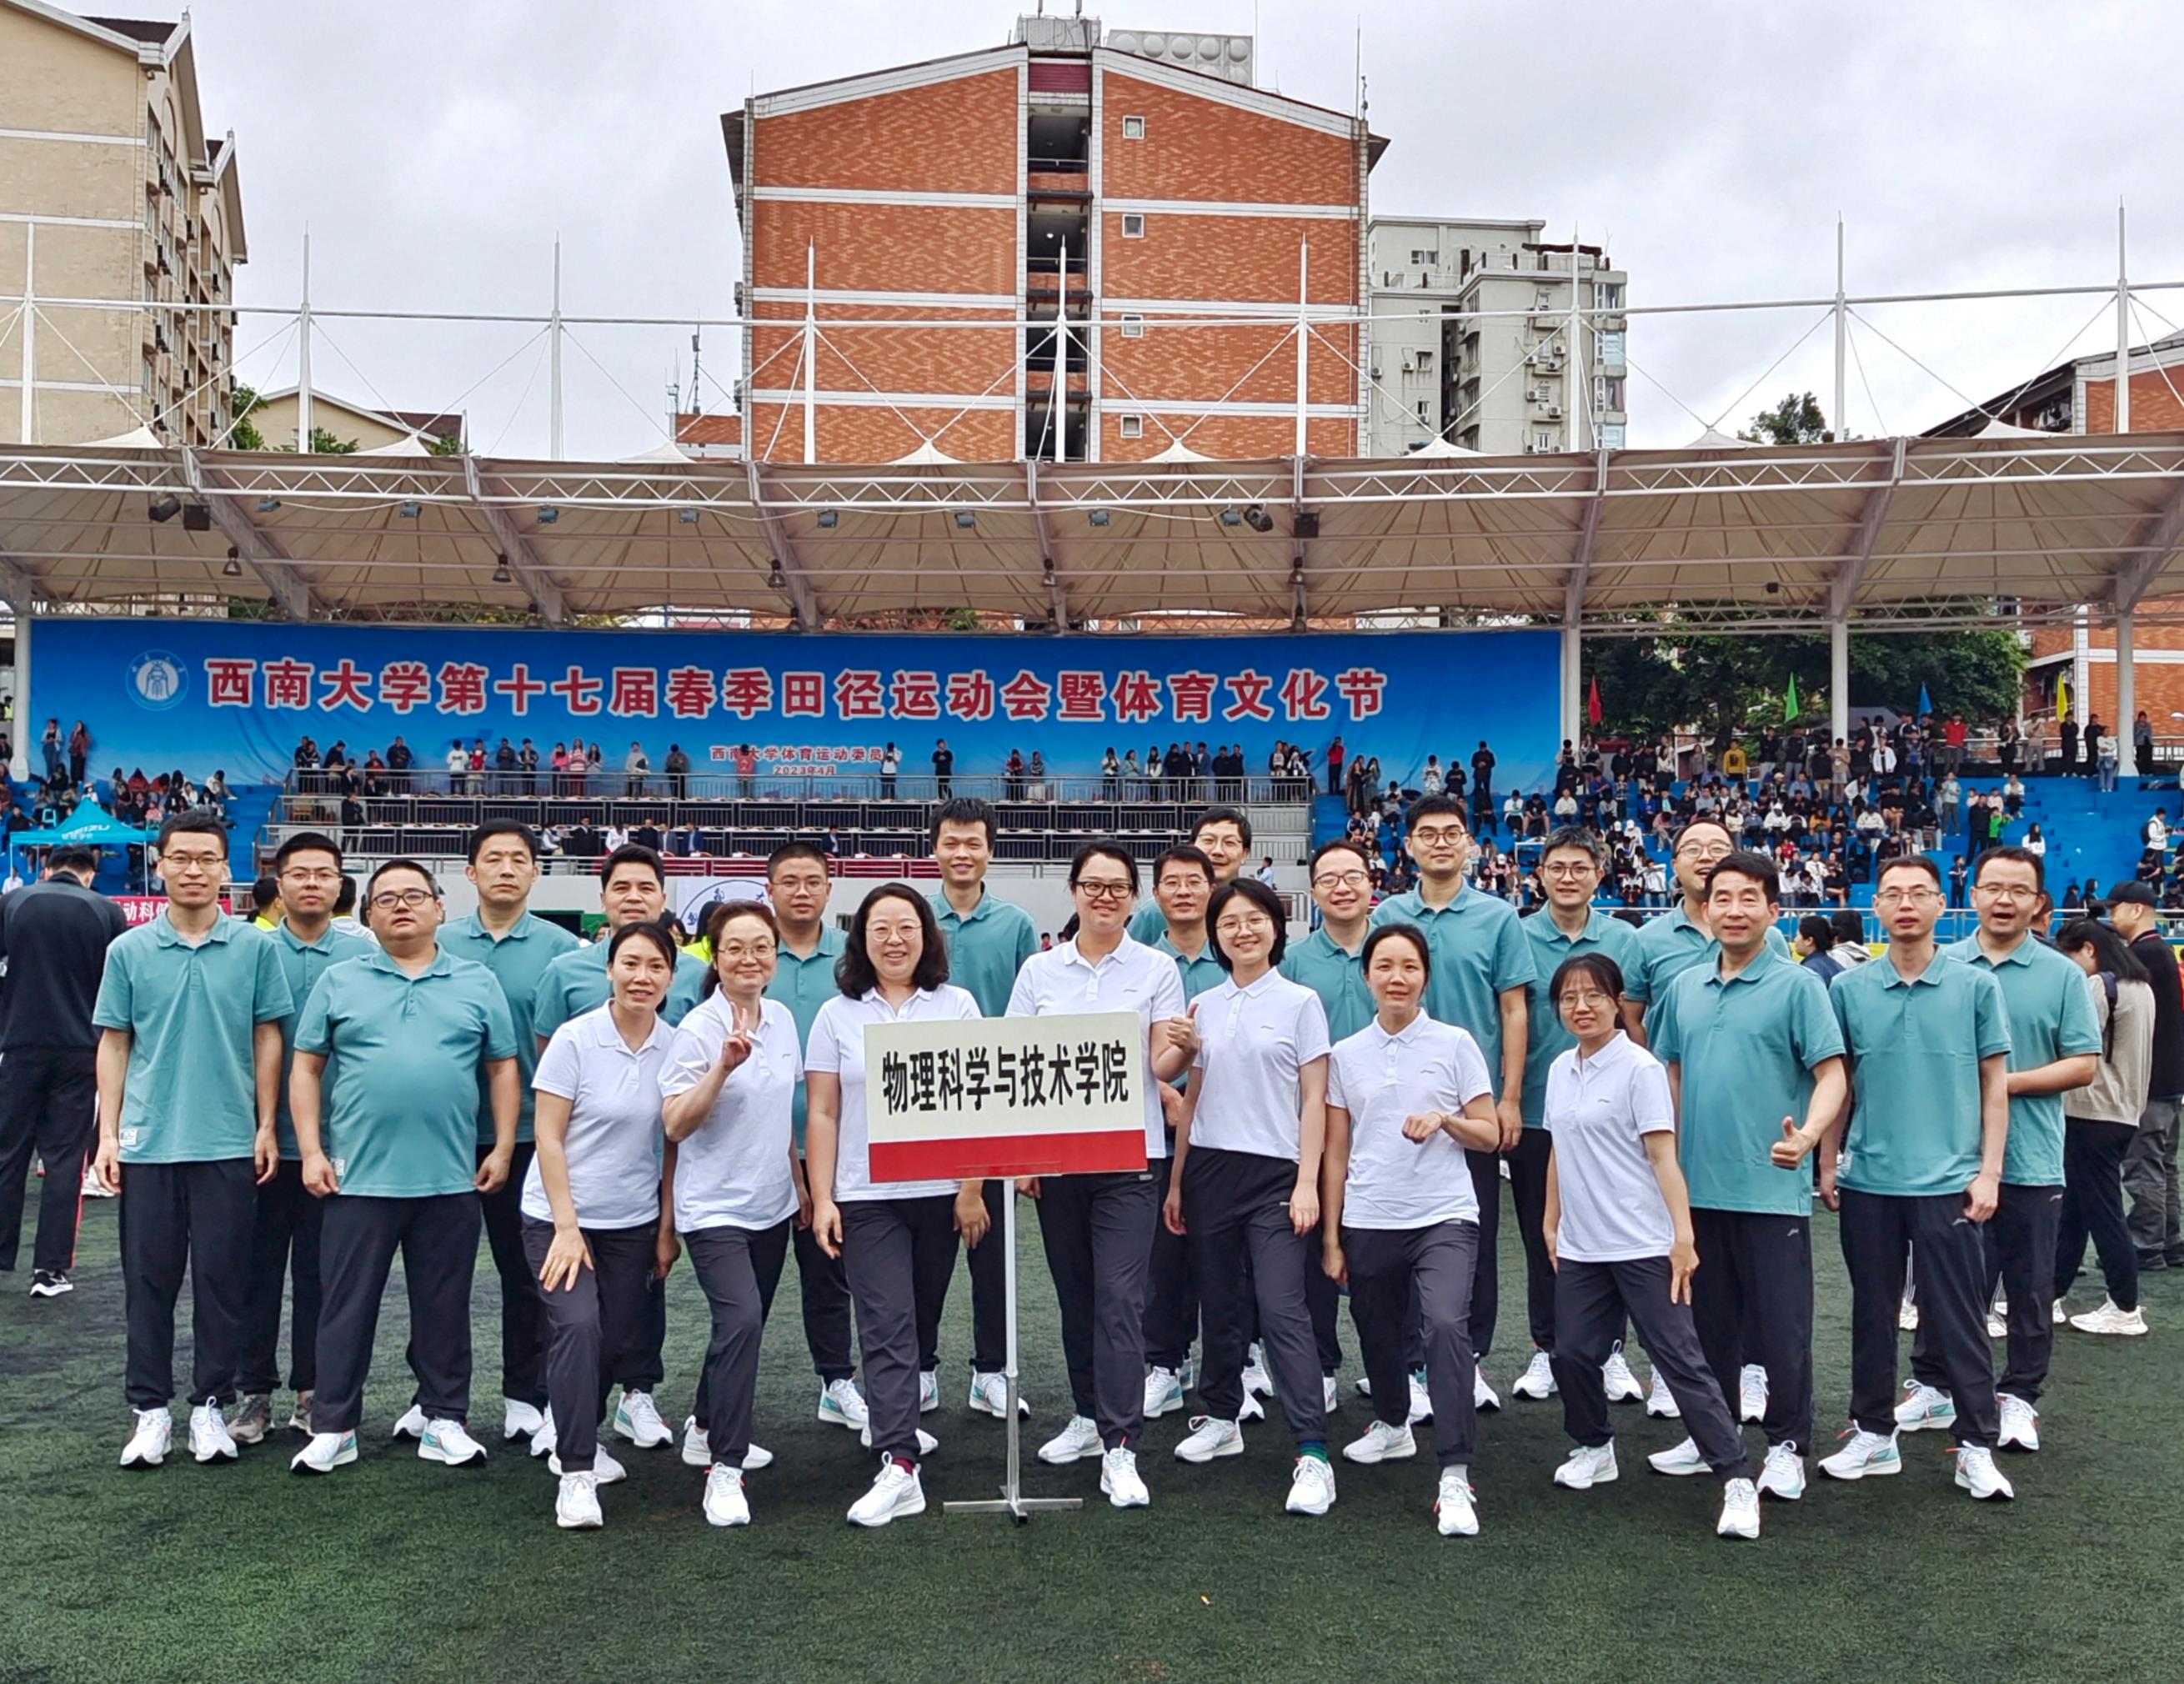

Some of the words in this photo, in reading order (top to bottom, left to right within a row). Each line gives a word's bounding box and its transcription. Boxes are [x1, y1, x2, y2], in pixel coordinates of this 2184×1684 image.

[205, 658, 1387, 721] 西南大学第十七届春季田径运动会暨体育文化节
[711, 746, 901, 762] 西大学体育运动委员
[882, 1040, 1128, 1115] 物理科学与技术学院
